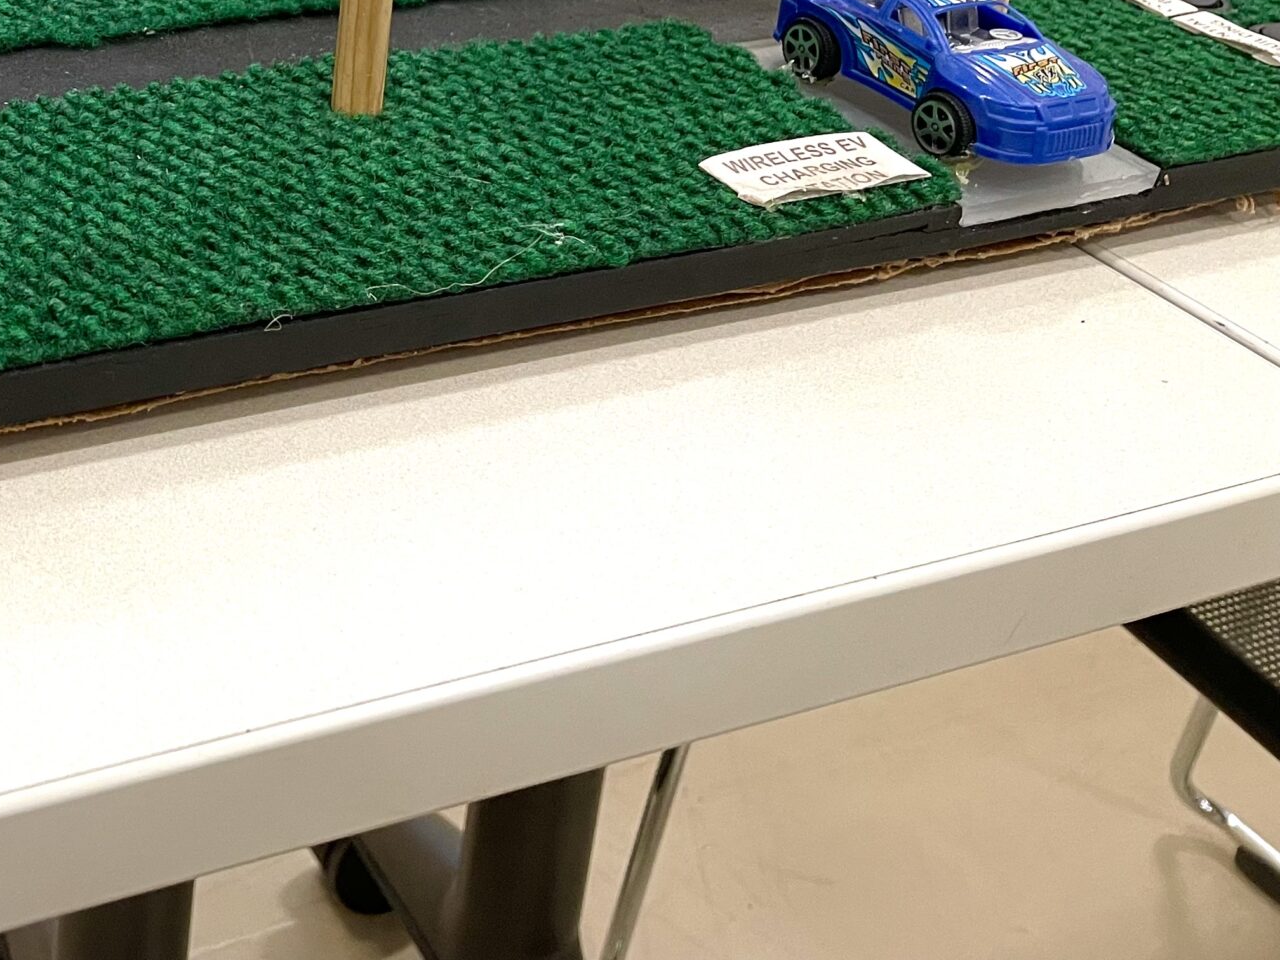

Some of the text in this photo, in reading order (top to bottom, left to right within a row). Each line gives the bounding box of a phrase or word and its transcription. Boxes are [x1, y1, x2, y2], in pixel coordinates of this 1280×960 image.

[722, 136, 867, 174] WIRELESS EV
[759, 156, 877, 186] CHARGING
